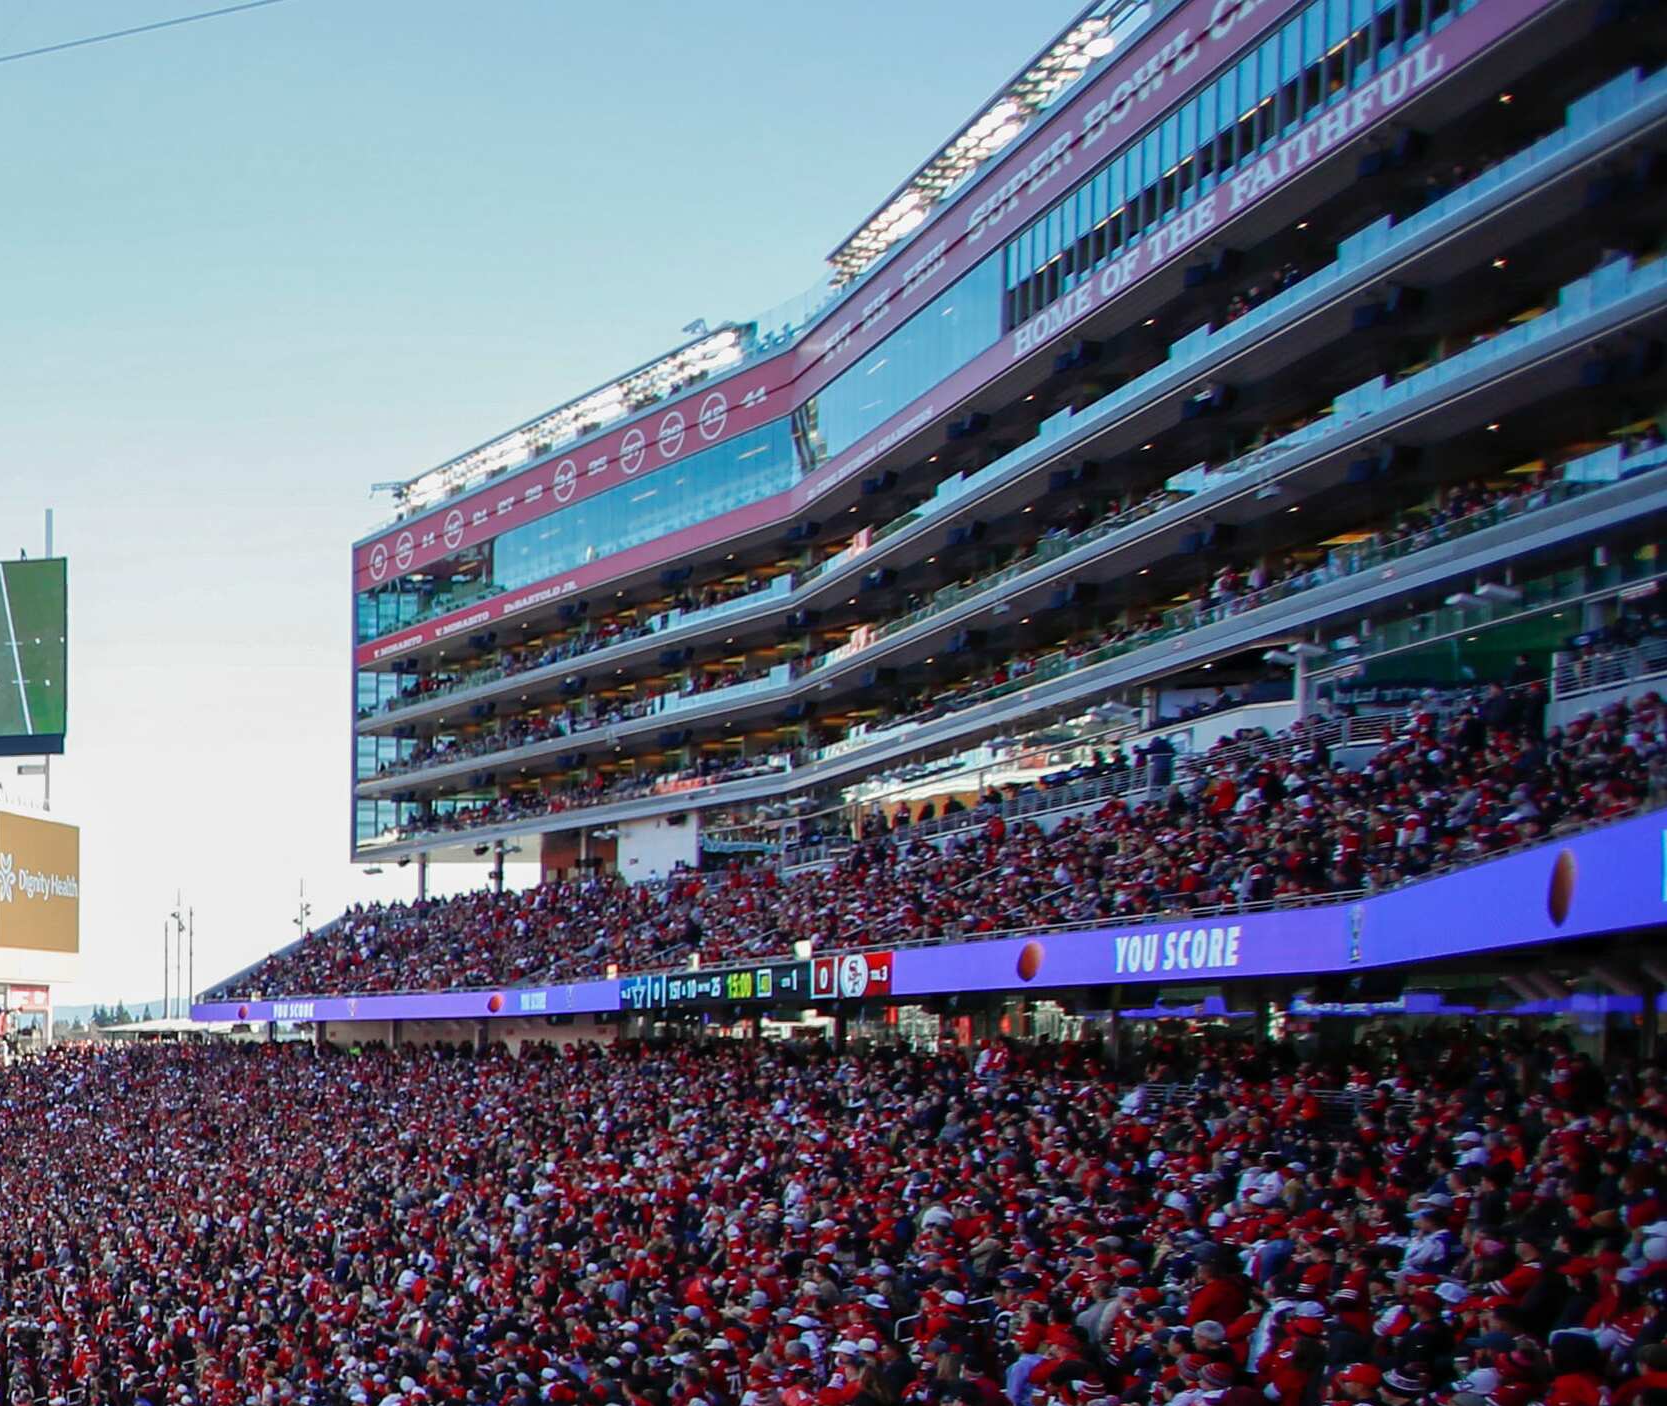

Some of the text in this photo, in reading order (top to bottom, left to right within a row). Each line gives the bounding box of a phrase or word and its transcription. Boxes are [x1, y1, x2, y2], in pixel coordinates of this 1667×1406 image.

[1012, 44, 1444, 357] HOME OF THE FAITHFUL
[19, 869, 78, 900] Dignity Health
[1115, 925, 1244, 973] YOU SCORE
[727, 972, 753, 999] 15:00
